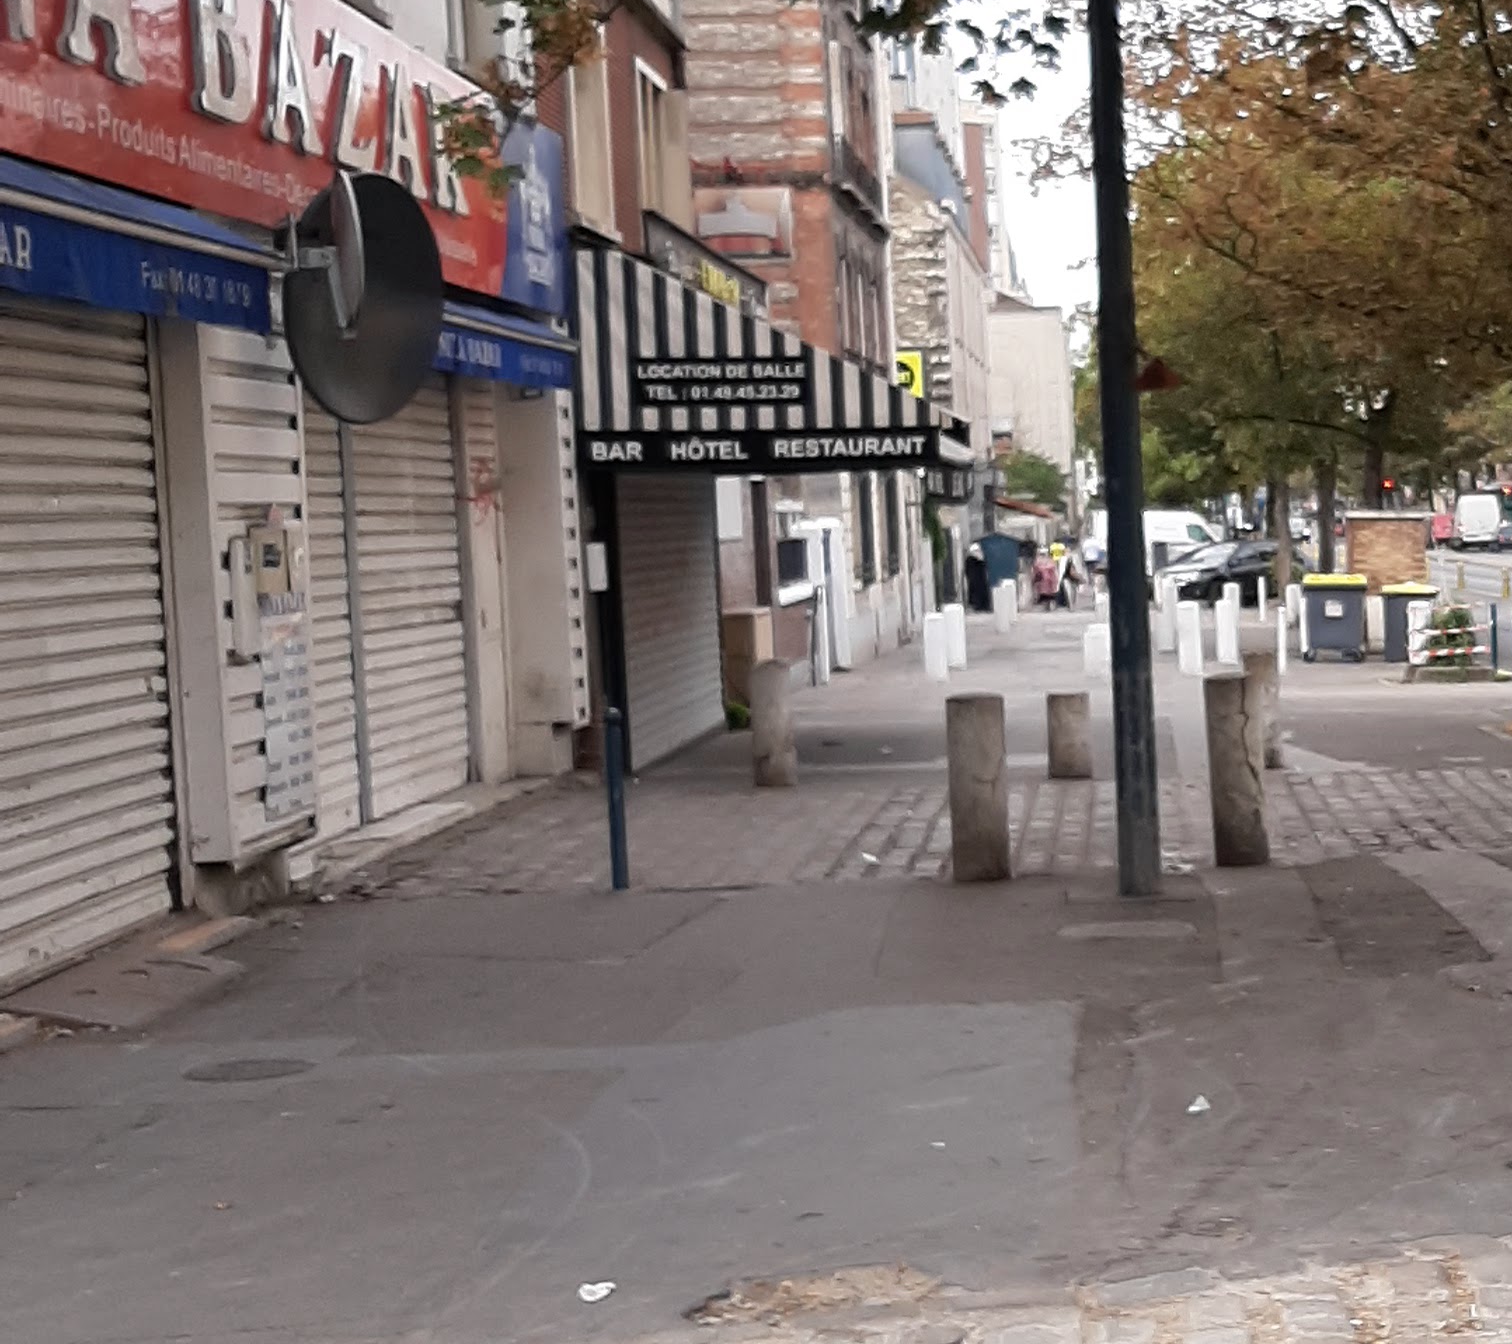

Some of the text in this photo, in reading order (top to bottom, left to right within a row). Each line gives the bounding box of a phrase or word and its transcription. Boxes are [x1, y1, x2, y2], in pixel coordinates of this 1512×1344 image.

[637, 362, 806, 380] LOCATION DE SALLE
[646, 385, 678, 400] TEL
[591, 435, 927, 462] BAR HÔTEL RESTAURANT
